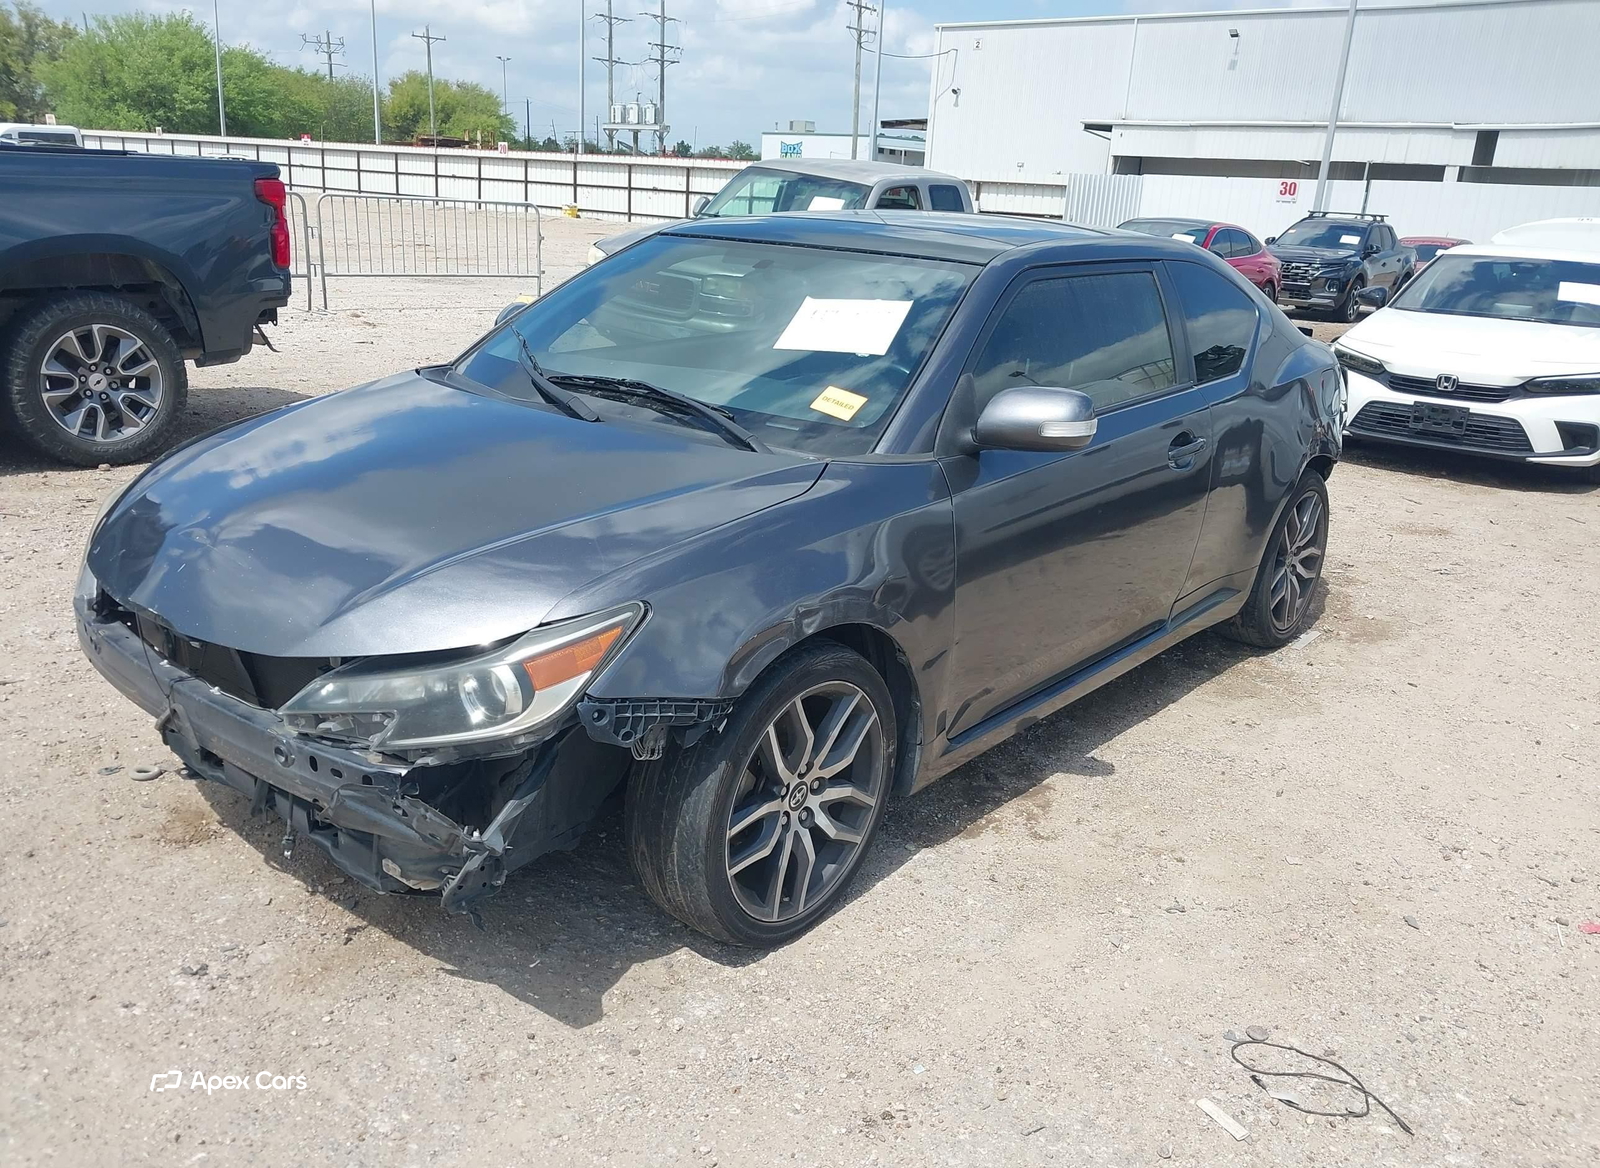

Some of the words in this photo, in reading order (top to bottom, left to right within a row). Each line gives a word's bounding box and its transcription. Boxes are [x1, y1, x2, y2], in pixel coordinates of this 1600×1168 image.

[499, 144, 507, 154] 20
[780, 140, 803, 154] BOX
[1279, 181, 1298, 196] 30
[821, 395, 855, 410] DETAILED
